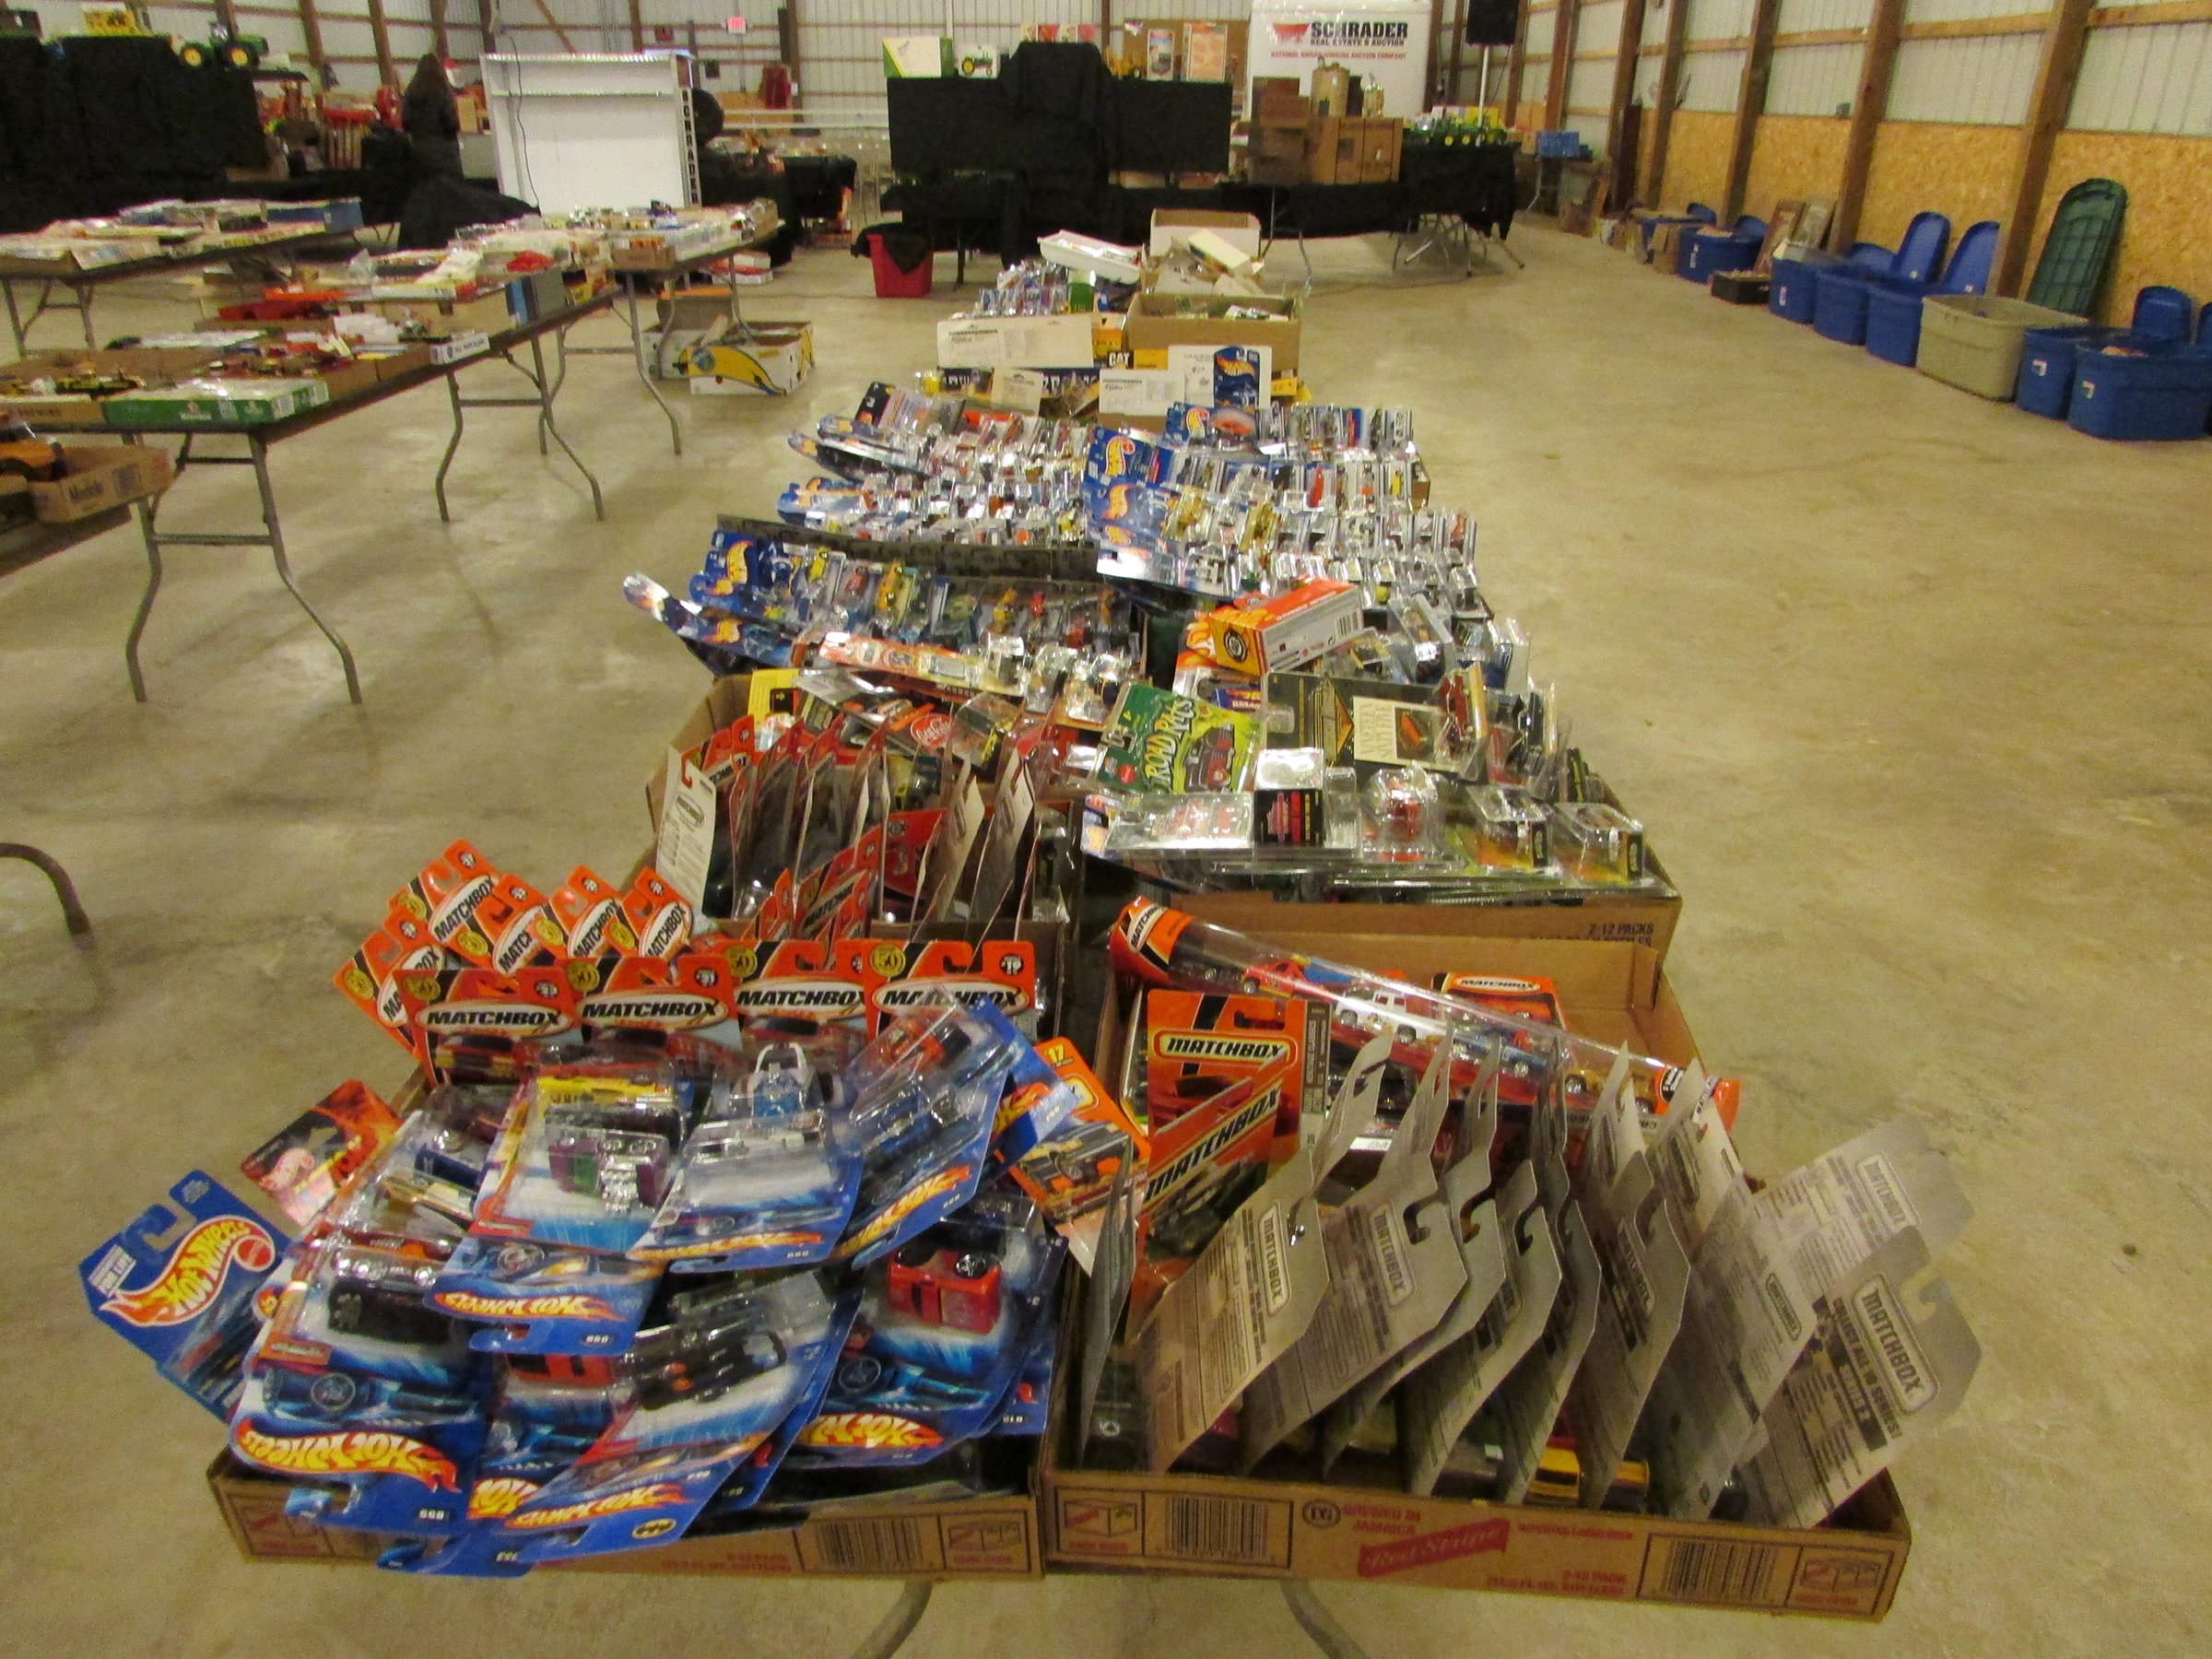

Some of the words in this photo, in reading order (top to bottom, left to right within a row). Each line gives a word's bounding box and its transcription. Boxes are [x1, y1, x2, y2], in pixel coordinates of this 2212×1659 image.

[1109, 351, 1130, 367] CAT
[434, 875, 496, 942] MATCHBOX
[427, 1011, 562, 1026] MATCHBOX
[582, 1000, 718, 1018] MATCHBOX
[1166, 1037, 1284, 1058] MATCHBOX
[1143, 1086, 1282, 1202] MATCHBOX
[1264, 1217, 1285, 1302] MATCHBOX
[1862, 1288, 1924, 1394] MATCHBOX
